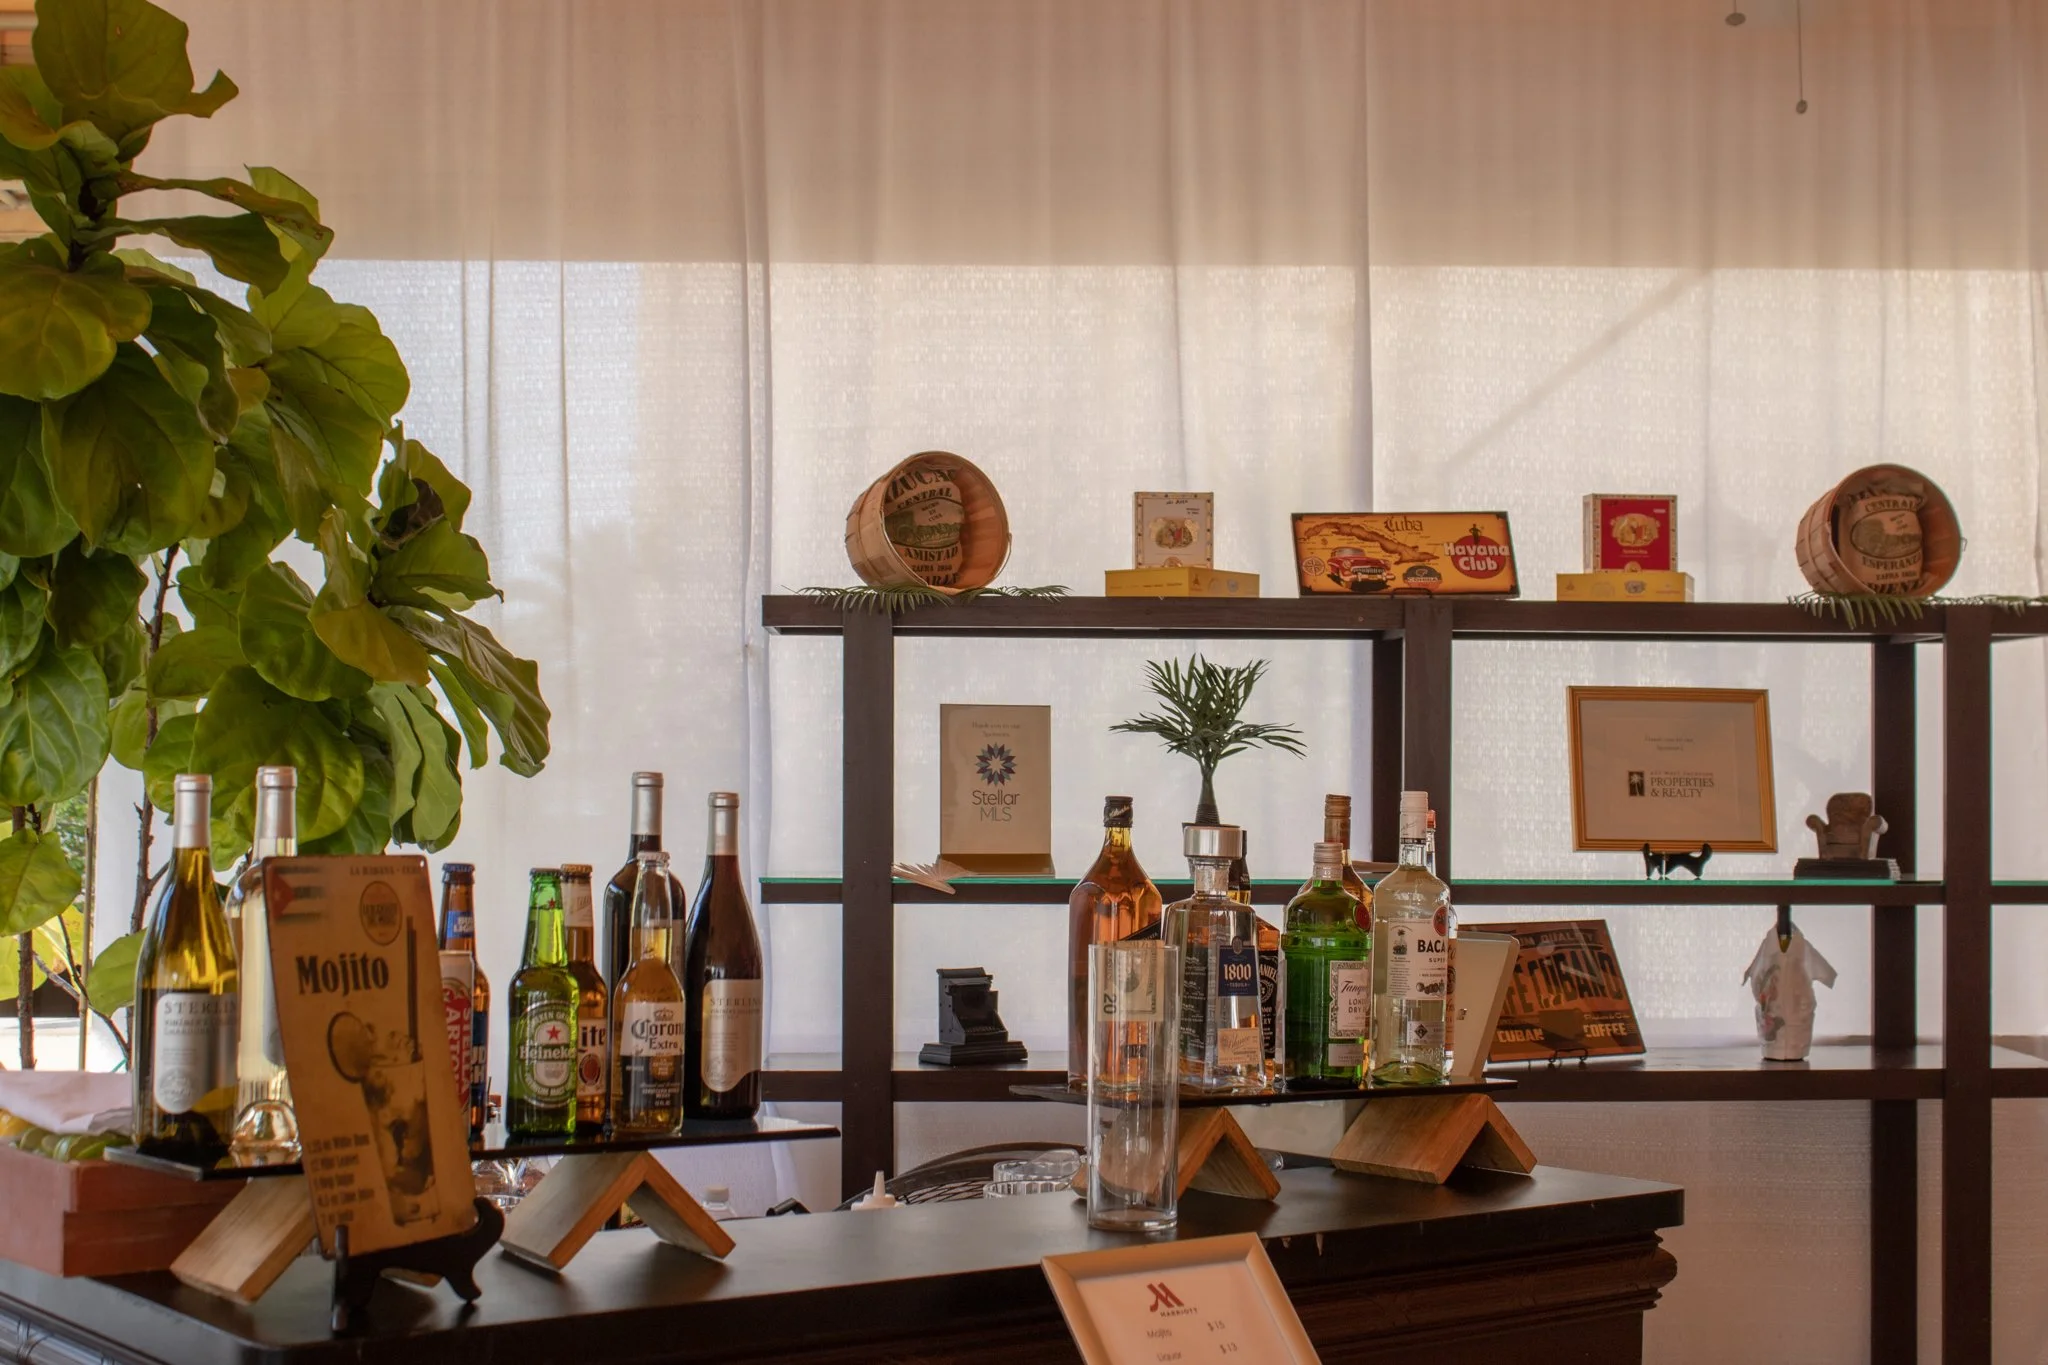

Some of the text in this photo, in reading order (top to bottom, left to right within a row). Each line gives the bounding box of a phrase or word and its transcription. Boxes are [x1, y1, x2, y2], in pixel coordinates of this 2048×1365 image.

[897, 487, 952, 509] CENTRAL
[1865, 499, 1918, 513] CENTRAL
[1383, 515, 1424, 534] Cuba
[904, 546, 959, 562] AMISTAD
[1443, 541, 1511, 557] Havana
[1458, 558, 1498, 572] Club
[1650, 777, 1715, 788] PROPERTIES
[971, 789, 1021, 807] Stellar
[1650, 788, 1704, 799] & REALTY
[979, 807, 1012, 822] MLS
[1417, 939, 1446, 953] BACA
[295, 952, 390, 997] Mojito
[1223, 963, 1252, 981] 1800
[1528, 951, 1623, 1009] CUBANO
[163, 1001, 237, 1015] STERLIN
[710, 997, 760, 1007] STERLIN
[1103, 993, 1117, 1014] 20
[631, 1019, 684, 1042] Coron
[1497, 1028, 1544, 1043] CUBAN
[1584, 1023, 1628, 1038] COFFEE
[461, 1007, 470, 1093] STELLA
[648, 1037, 678, 1050] Extra
[1160, 1308, 1198, 1318] MARRIOTT
